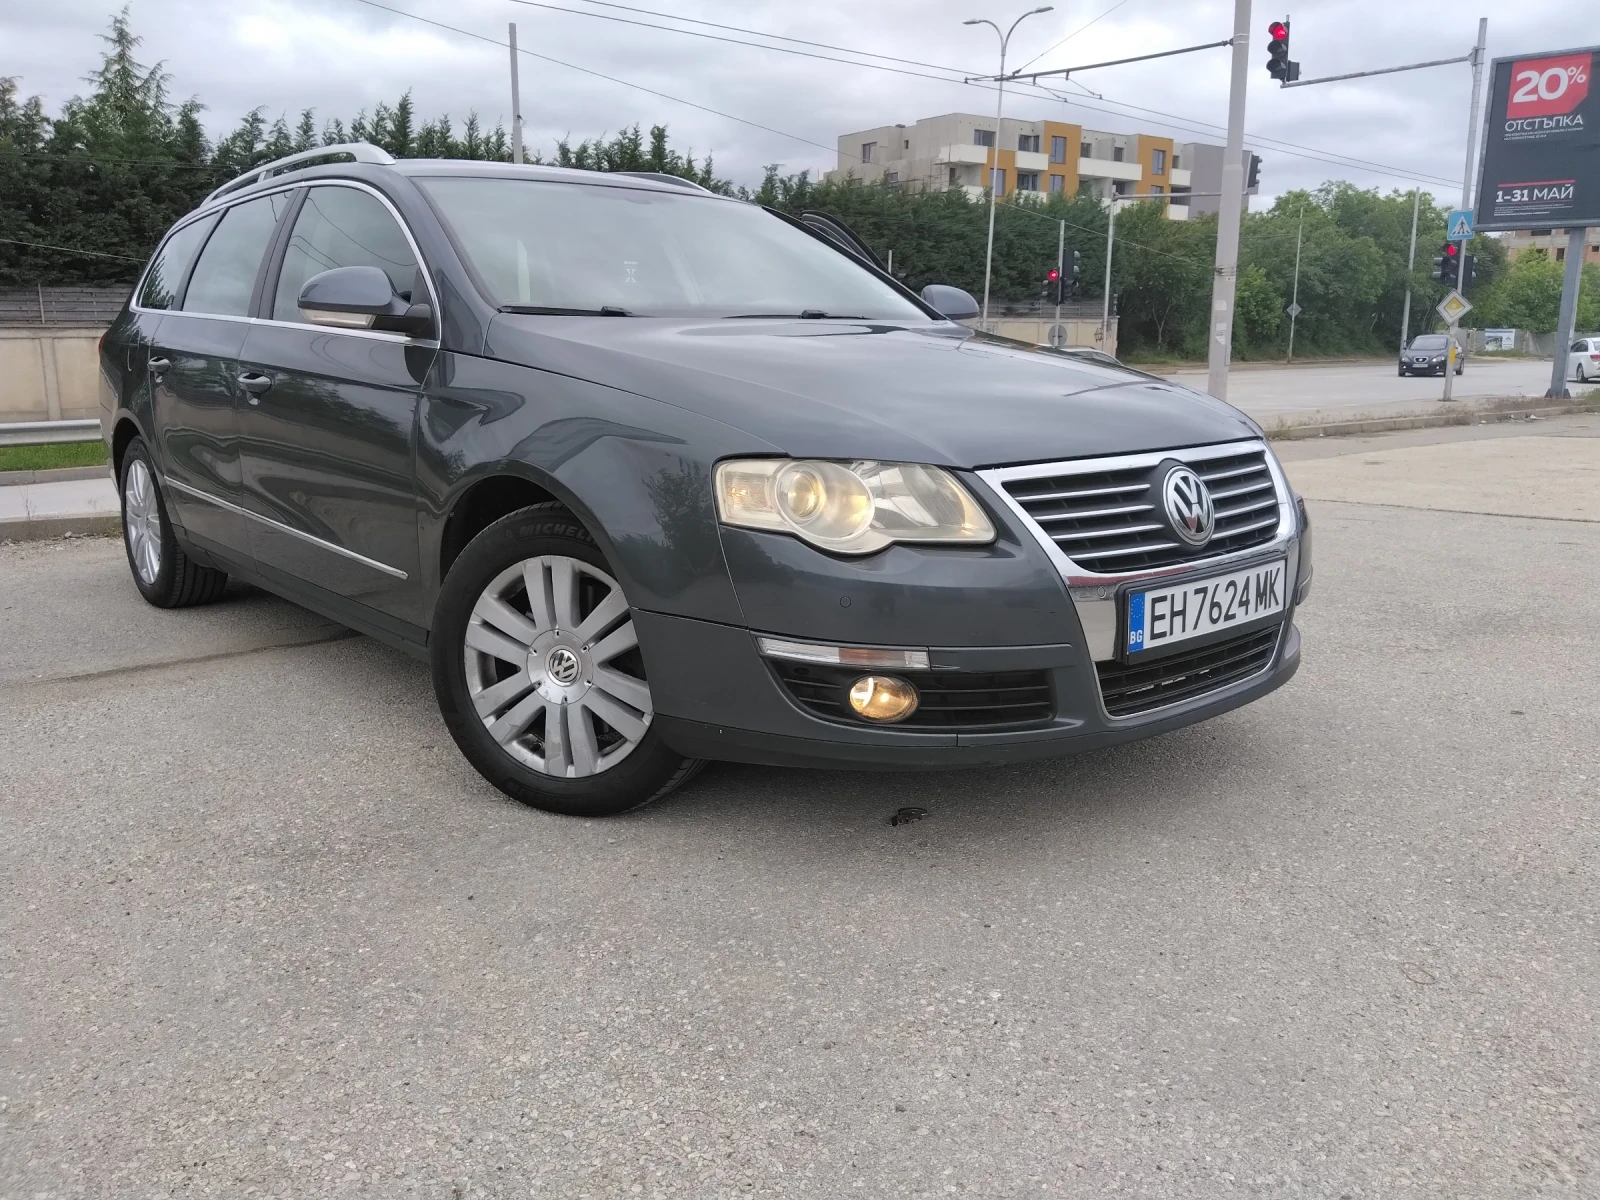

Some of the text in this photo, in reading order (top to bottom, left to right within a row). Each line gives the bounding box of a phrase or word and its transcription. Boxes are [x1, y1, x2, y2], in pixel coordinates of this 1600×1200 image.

[1512, 65, 1587, 103] 20%
[1504, 115, 1584, 132] ОТСТЪПКА
[1495, 184, 1575, 203] 1-31 МАЙ
[1150, 566, 1281, 641] EH 7624 MK
[1129, 629, 1143, 645] BG
